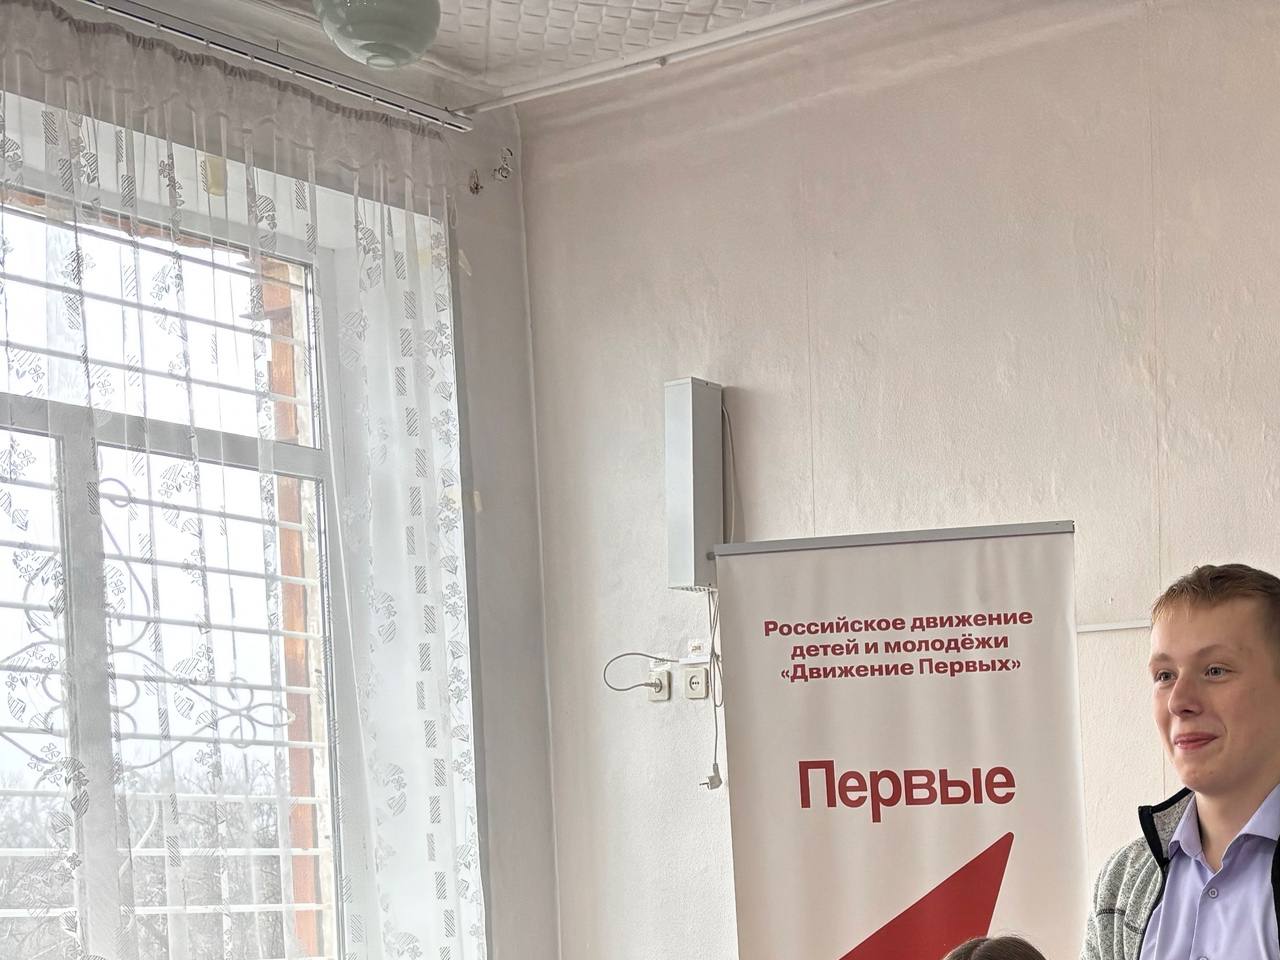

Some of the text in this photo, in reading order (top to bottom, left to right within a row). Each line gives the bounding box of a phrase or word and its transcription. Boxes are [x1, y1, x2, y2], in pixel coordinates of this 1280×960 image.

[764, 609, 1034, 637] Российское движение
[791, 634, 1009, 660] детей и молодёжи
[781, 657, 1021, 682] «Движение Первых»
[798, 760, 1016, 823] Первые
